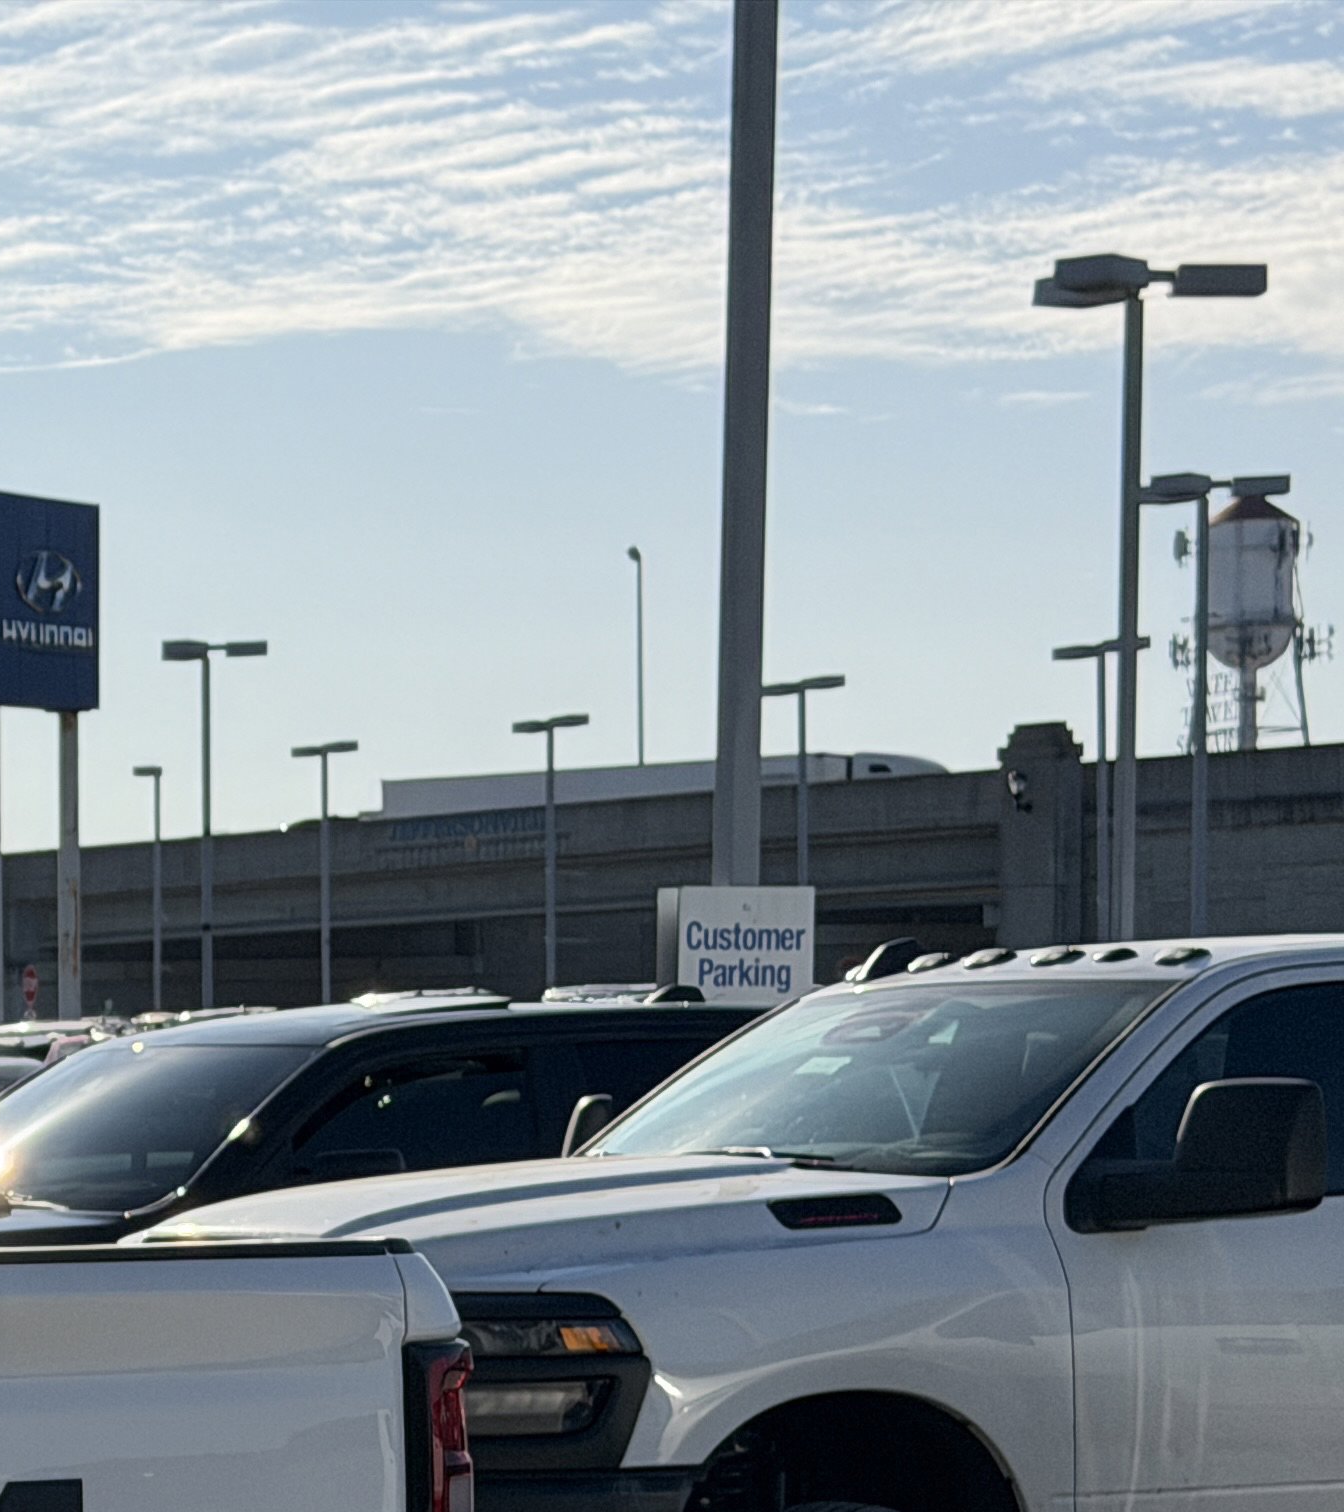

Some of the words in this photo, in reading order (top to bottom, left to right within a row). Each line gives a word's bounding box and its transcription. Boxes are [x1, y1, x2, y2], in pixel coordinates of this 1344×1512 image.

[2, 618, 93, 647] HYUNDAI
[686, 920, 806, 951] Customer
[698, 957, 791, 993] Parking
